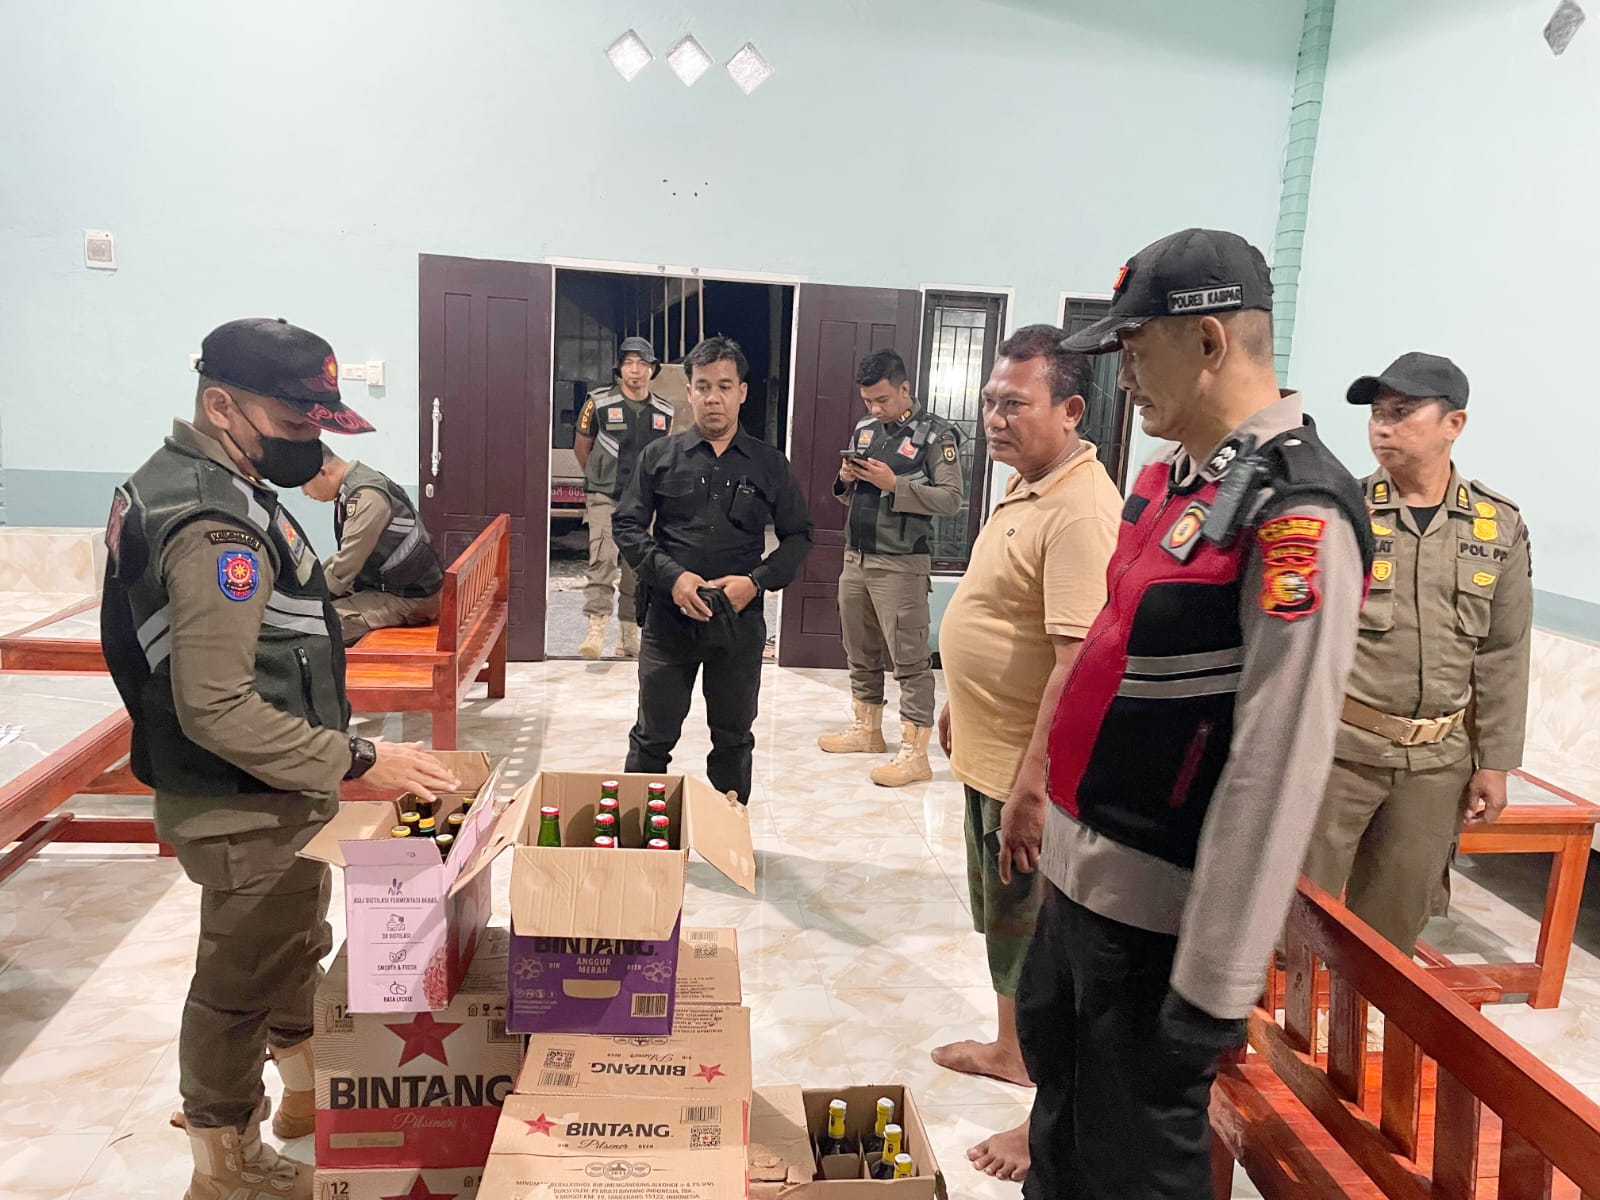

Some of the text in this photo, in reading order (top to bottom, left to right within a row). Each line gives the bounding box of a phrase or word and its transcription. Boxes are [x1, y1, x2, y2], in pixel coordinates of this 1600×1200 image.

[1169, 293, 1203, 309] POLRES
[1460, 541, 1488, 558] POL
[576, 957, 611, 966] ANGGUR
[578, 966, 608, 974] MERAH
[335, 1004, 353, 1019] 12
[590, 1062, 686, 1077] BINTANG
[330, 1074, 514, 1110] BINTANG
[566, 1122, 671, 1138] BINTANG
[331, 1181, 349, 1195] 12
